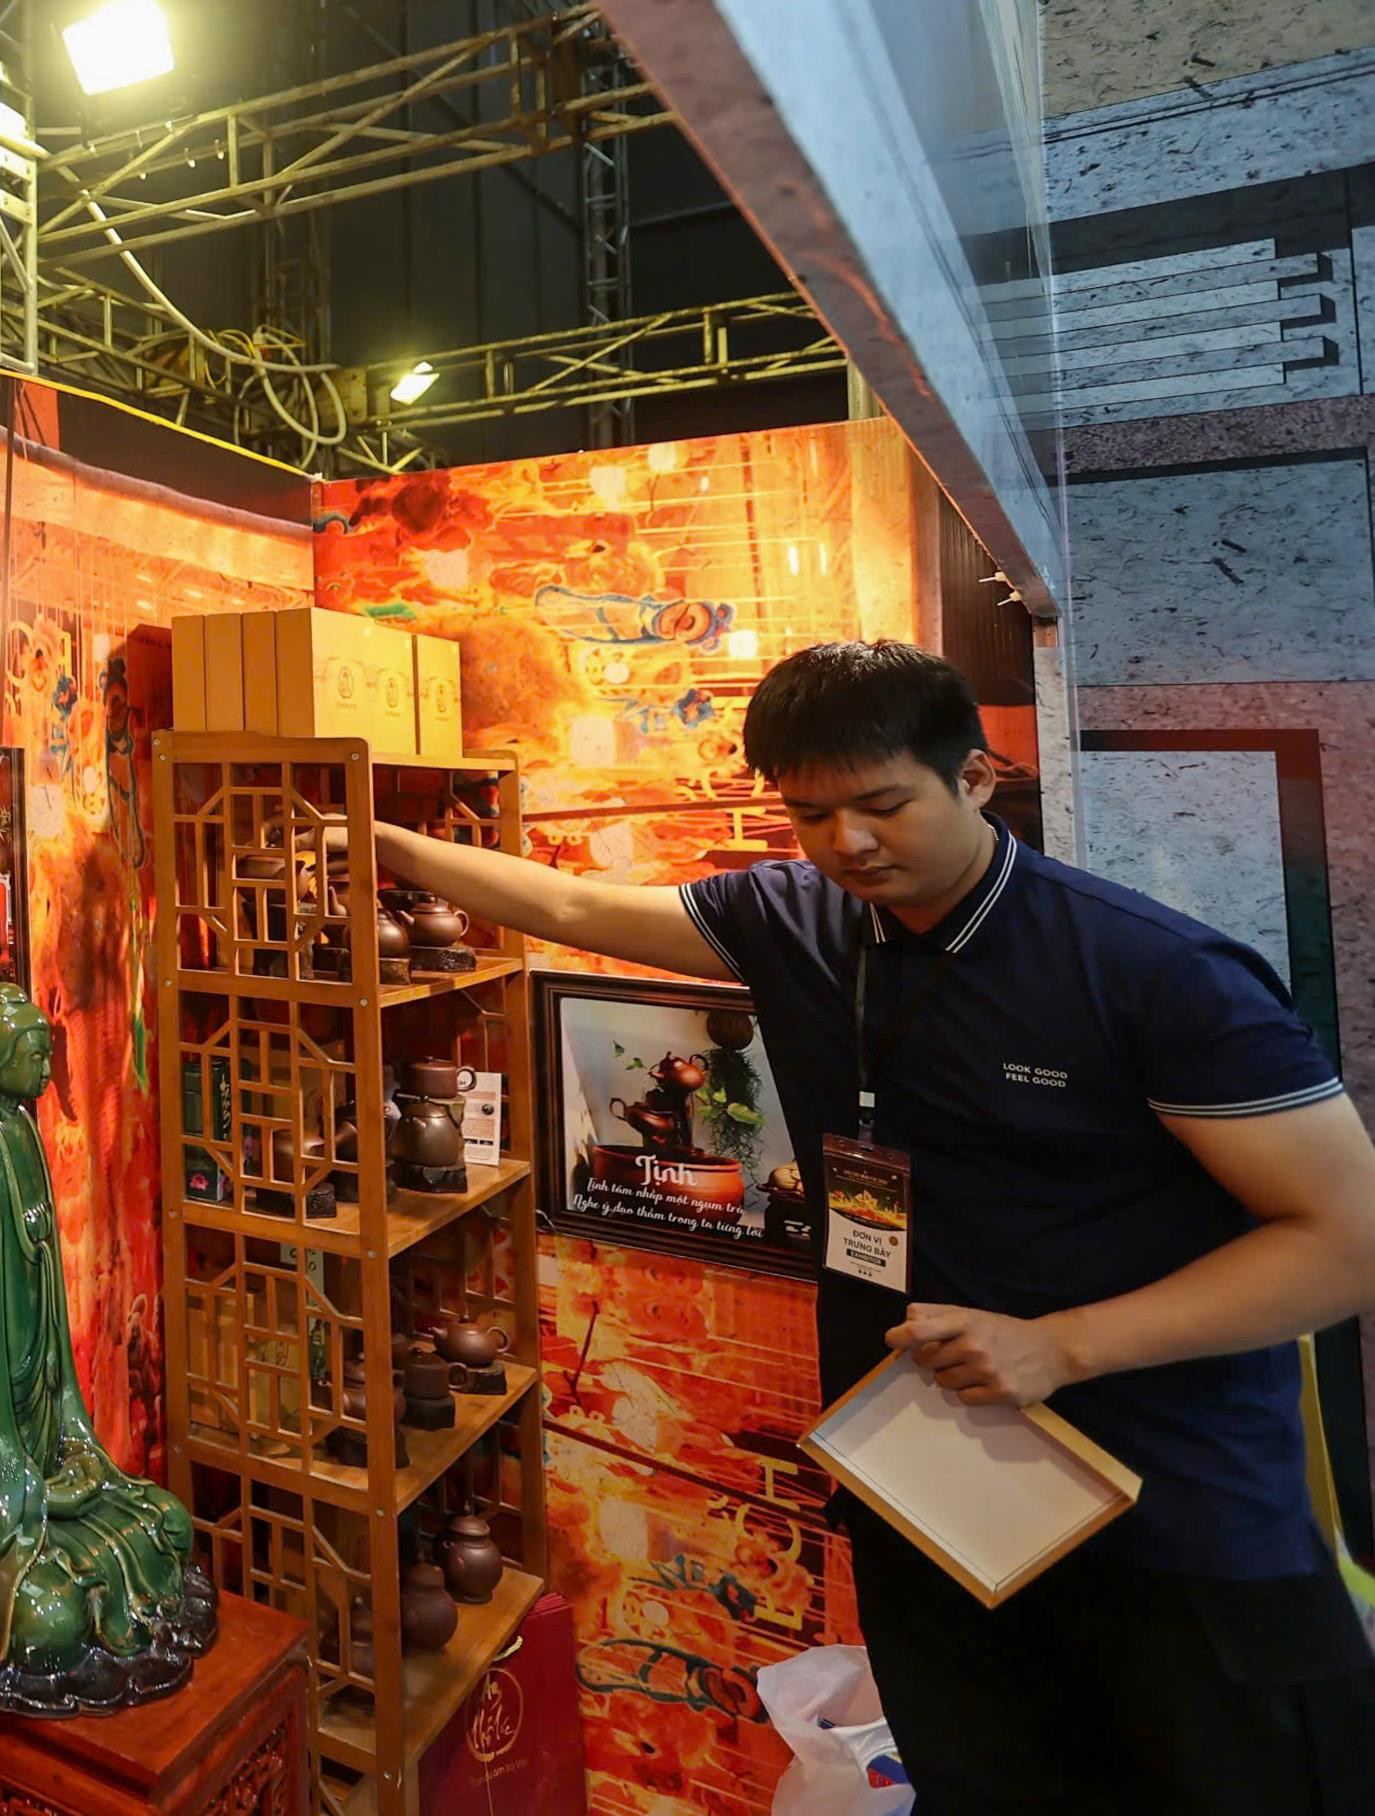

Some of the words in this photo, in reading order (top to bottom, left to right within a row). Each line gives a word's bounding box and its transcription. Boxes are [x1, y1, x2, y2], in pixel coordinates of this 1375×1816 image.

[1003, 1063, 1031, 1074] LOOK
[1035, 1067, 1067, 1079] GOOD
[1006, 1072, 1030, 1083] FEEL
[1032, 1077, 1066, 1087] GOOD
[635, 1154, 697, 1187] Tịnh
[666, 1195, 689, 1206] một
[573, 1194, 600, 1213] Nghe
[667, 1212, 698, 1232] trong
[701, 1218, 714, 1229] ta
[842, 1236, 872, 1253] TRƯNG
[873, 1235, 882, 1247] VỊ
